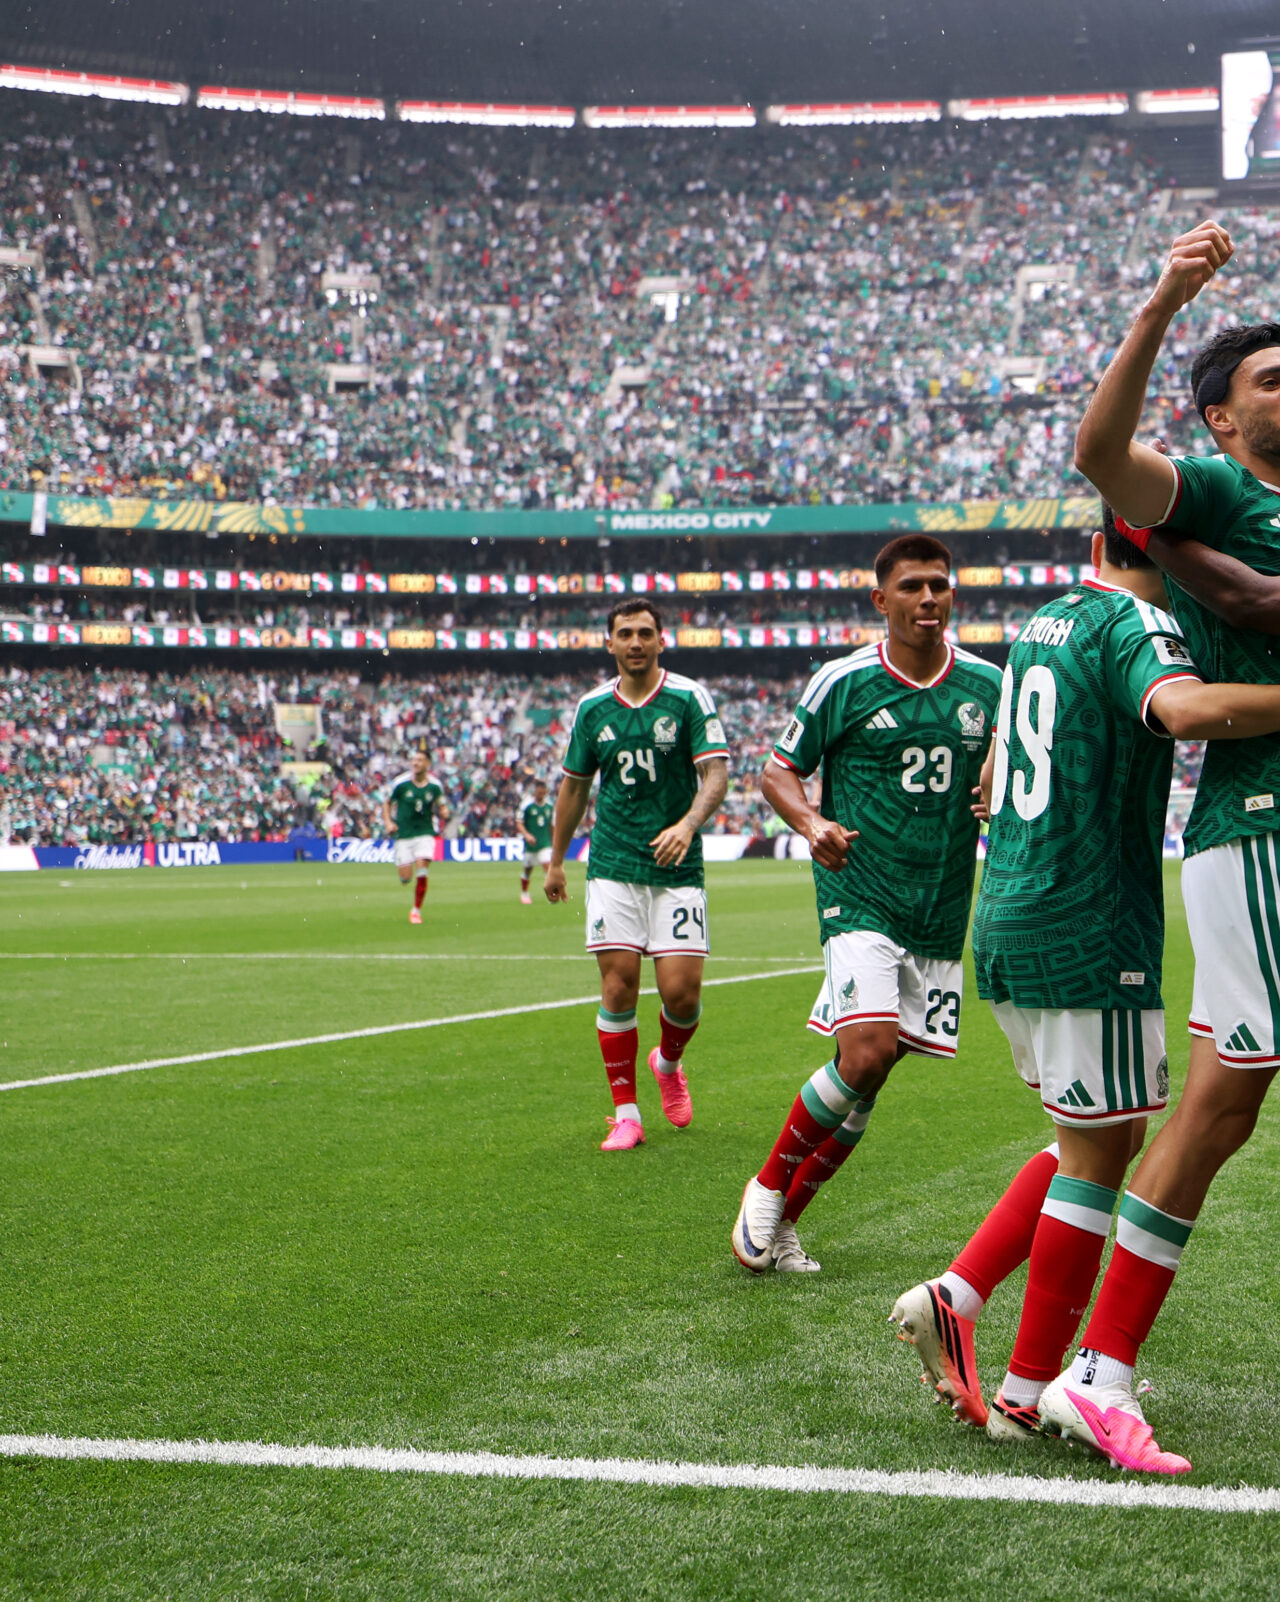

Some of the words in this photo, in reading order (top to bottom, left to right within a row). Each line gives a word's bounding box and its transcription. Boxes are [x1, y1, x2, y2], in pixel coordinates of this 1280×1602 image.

[611, 512, 710, 530] MEXICO
[712, 511, 771, 529] CITY
[957, 566, 1003, 585] MEXICO
[957, 624, 1004, 643] MEXICO
[990, 663, 1057, 821] 19
[617, 748, 657, 785] 24
[902, 746, 953, 793] 23
[74, 843, 142, 870] Michelob
[158, 841, 221, 867] ULTRA
[450, 838, 524, 862] ULTR
[672, 907, 705, 940] 24
[925, 988, 961, 1037] 23
